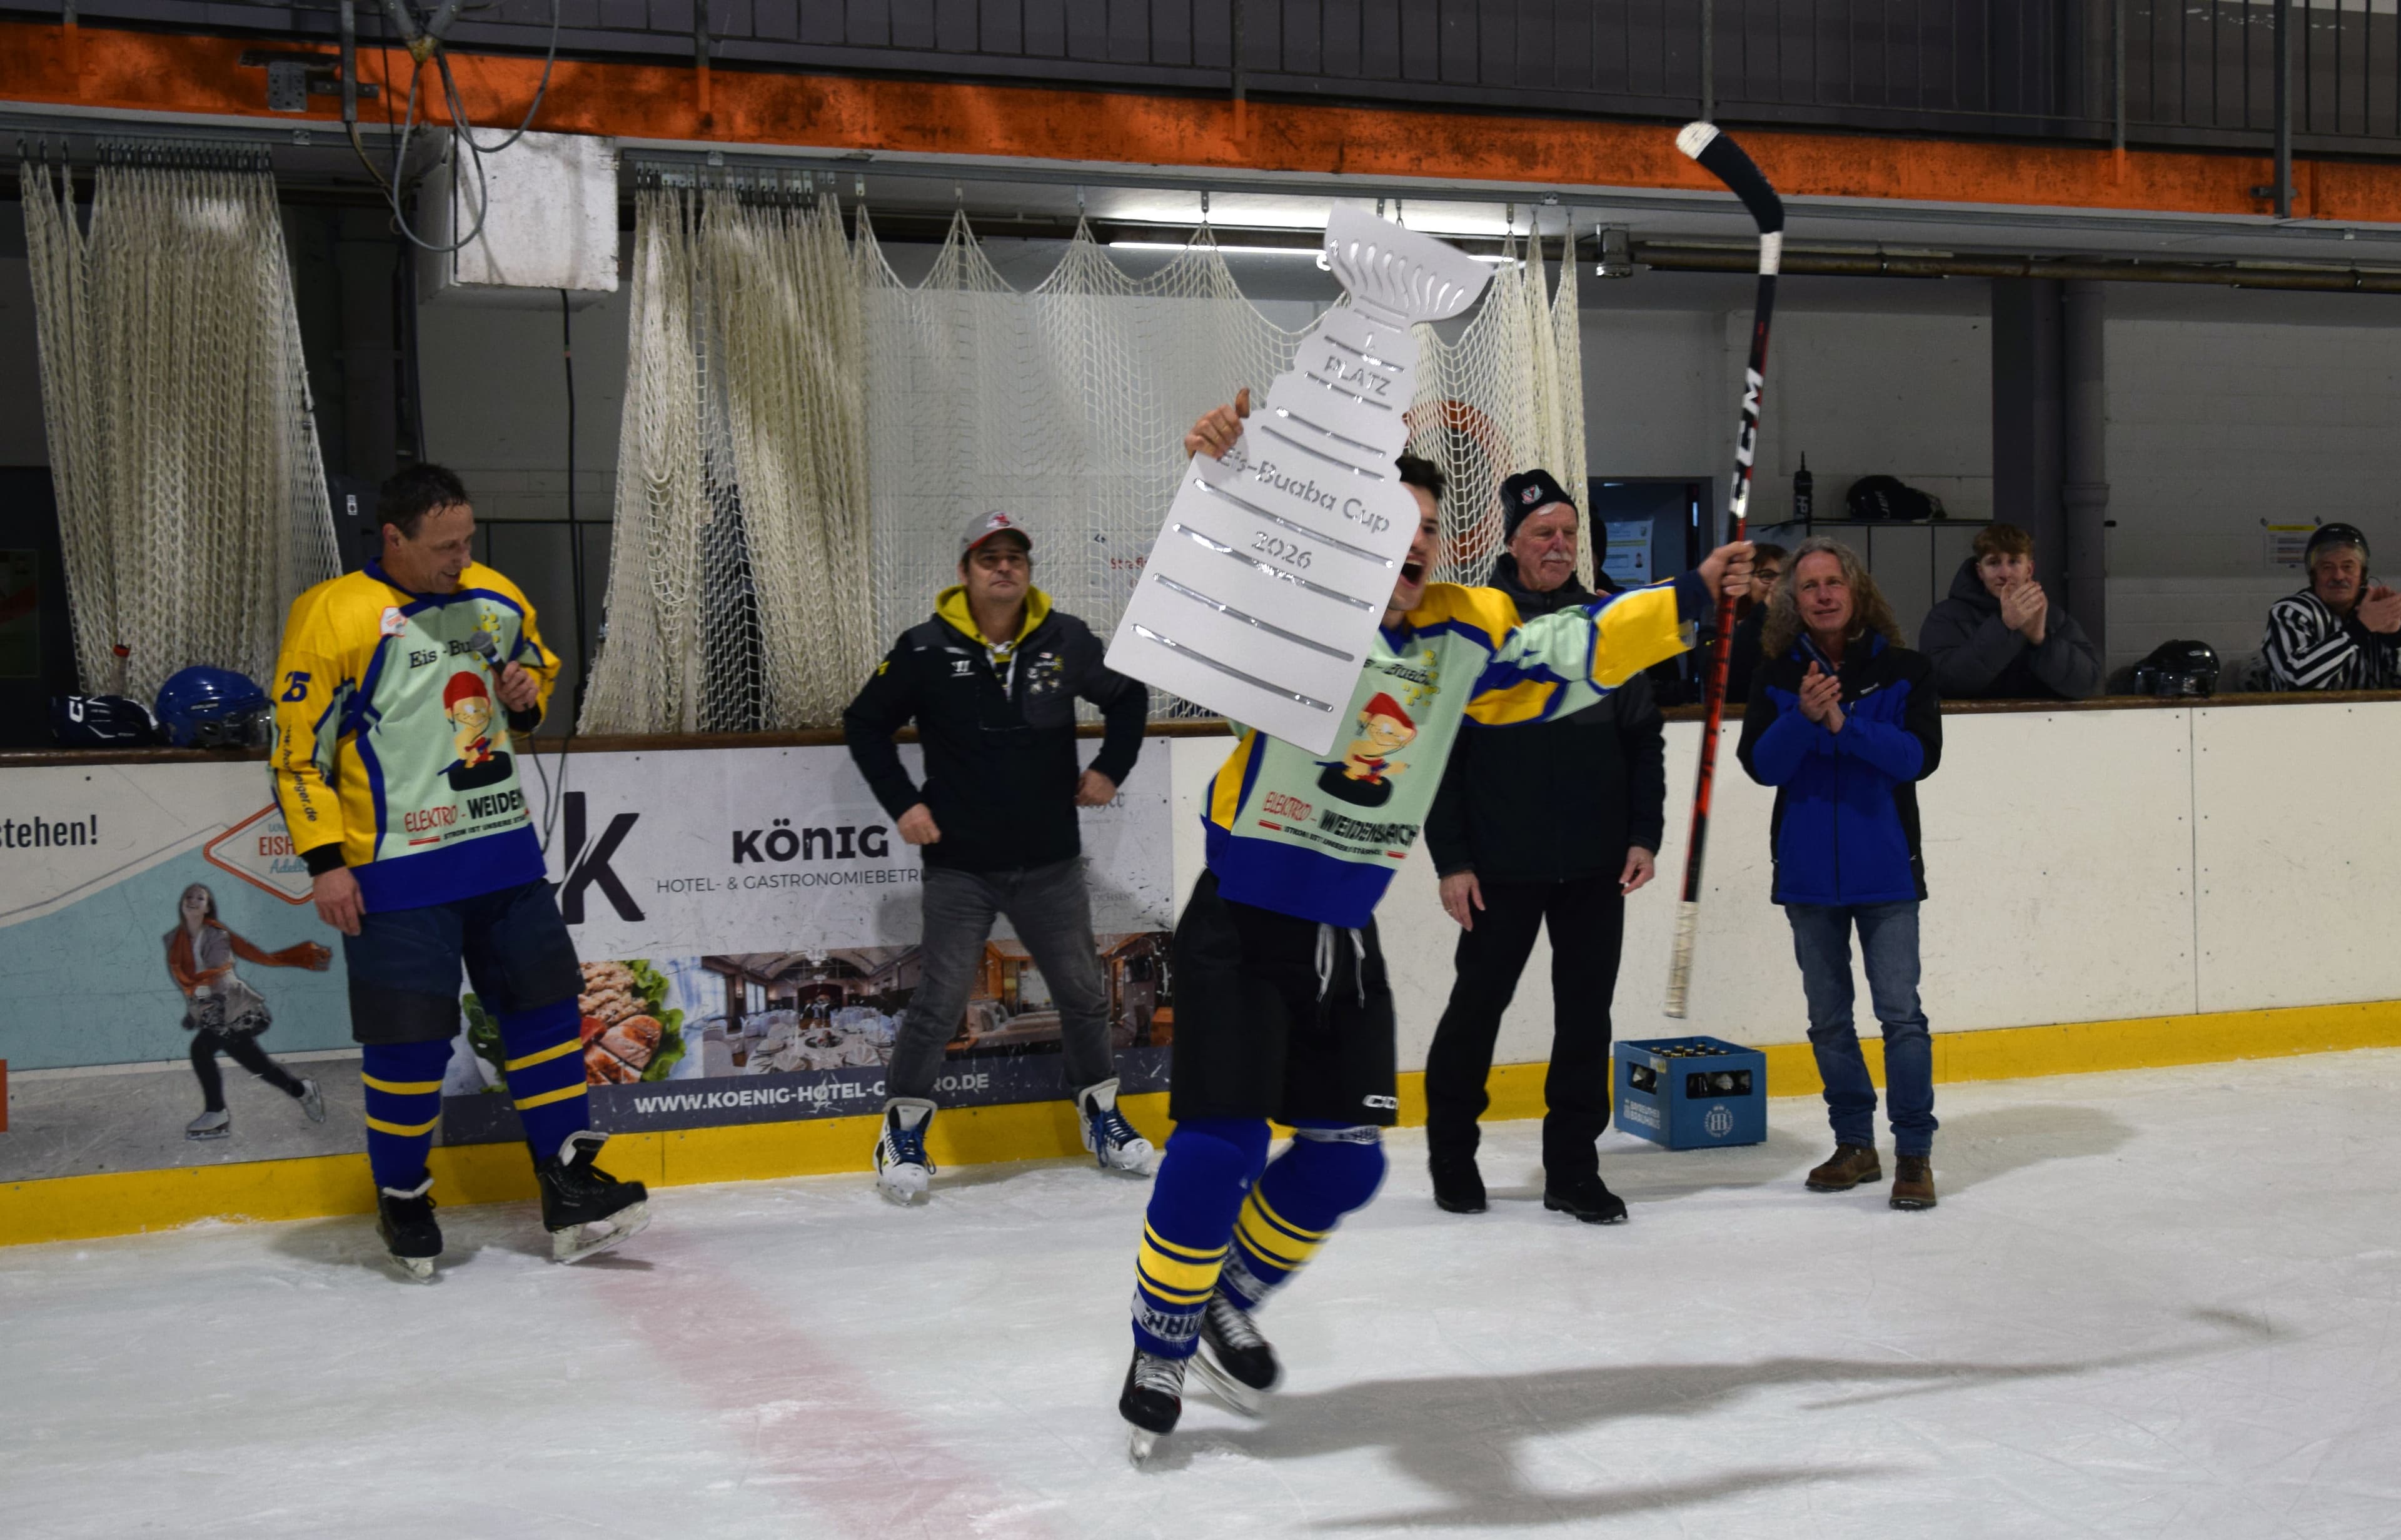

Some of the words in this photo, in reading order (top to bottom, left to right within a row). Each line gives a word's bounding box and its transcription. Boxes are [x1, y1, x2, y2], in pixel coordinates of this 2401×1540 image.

[1324, 355, 1391, 396] PLATZ
[1729, 368, 1763, 518] CCM
[1344, 498, 1389, 533] Cup
[1252, 531, 1312, 568] 2026
[0, 814, 97, 848] tehen!
[405, 804, 457, 832] ELEKTRO
[259, 836, 296, 856] EISH
[657, 877, 721, 893] HOTEL-
[727, 877, 738, 890] &
[743, 868, 923, 889] GASTRONOMIEBETRI
